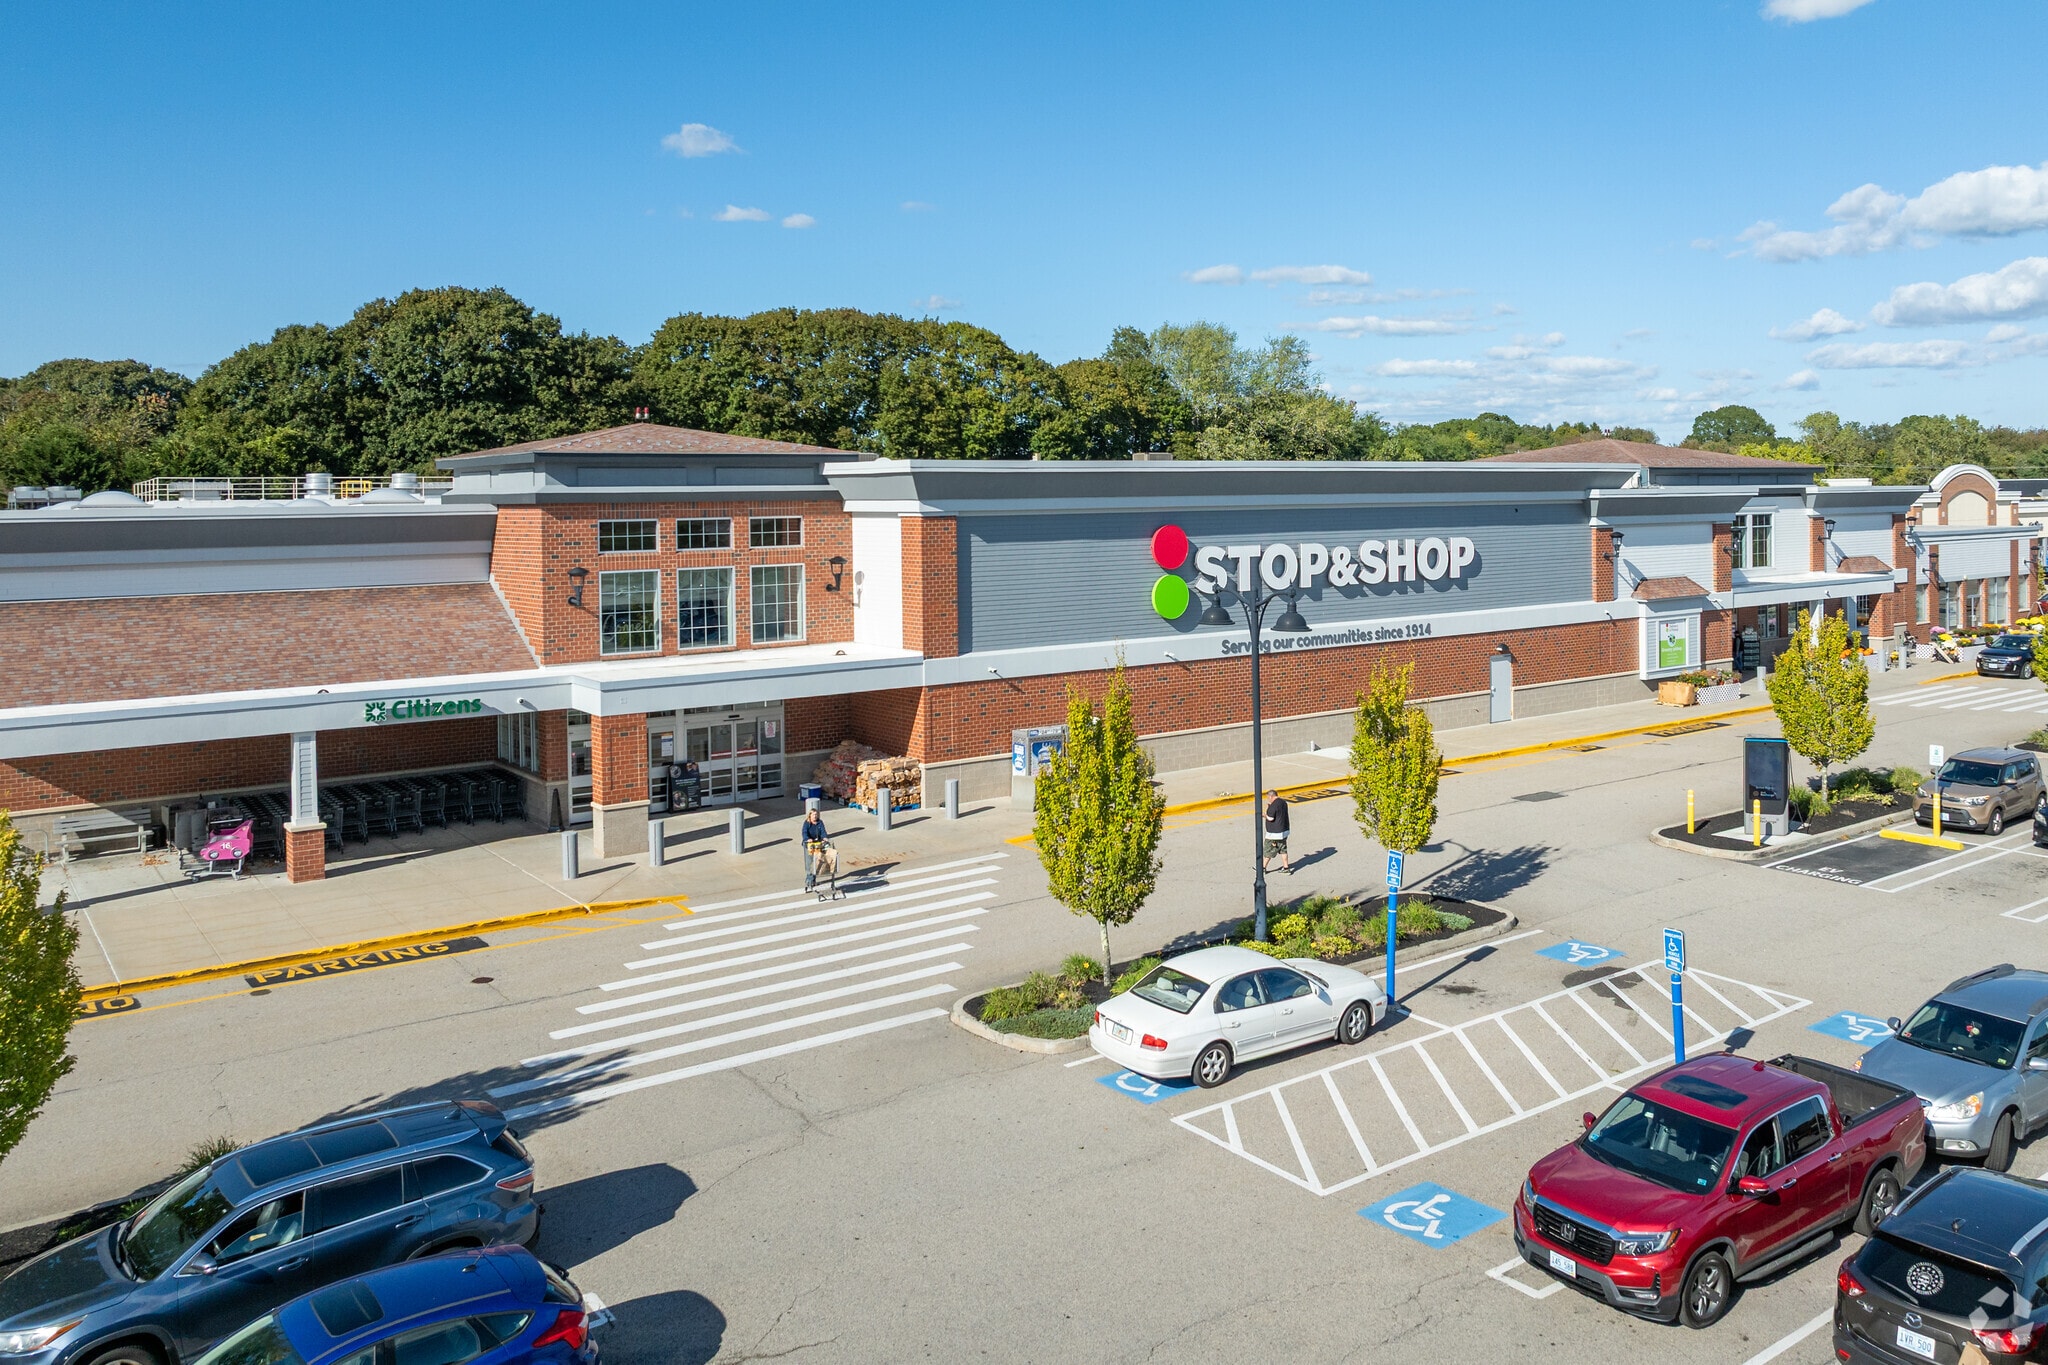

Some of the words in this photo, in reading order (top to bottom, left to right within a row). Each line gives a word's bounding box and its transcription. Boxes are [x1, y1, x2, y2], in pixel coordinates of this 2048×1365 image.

[1194, 537, 1475, 594] STOP&SHOP
[1221, 639, 1271, 655] Servng
[1273, 635, 1296, 650] our
[1296, 628, 1373, 647] communities
[1375, 626, 1403, 640] since
[1405, 623, 1431, 638] 1914
[391, 698, 483, 719] Citizens
[1775, 865, 1863, 885] CHARGING
[1818, 866, 1844, 874] EV
[254, 941, 450, 985] PARKING
[1918, 1339, 1932, 1353] 500
